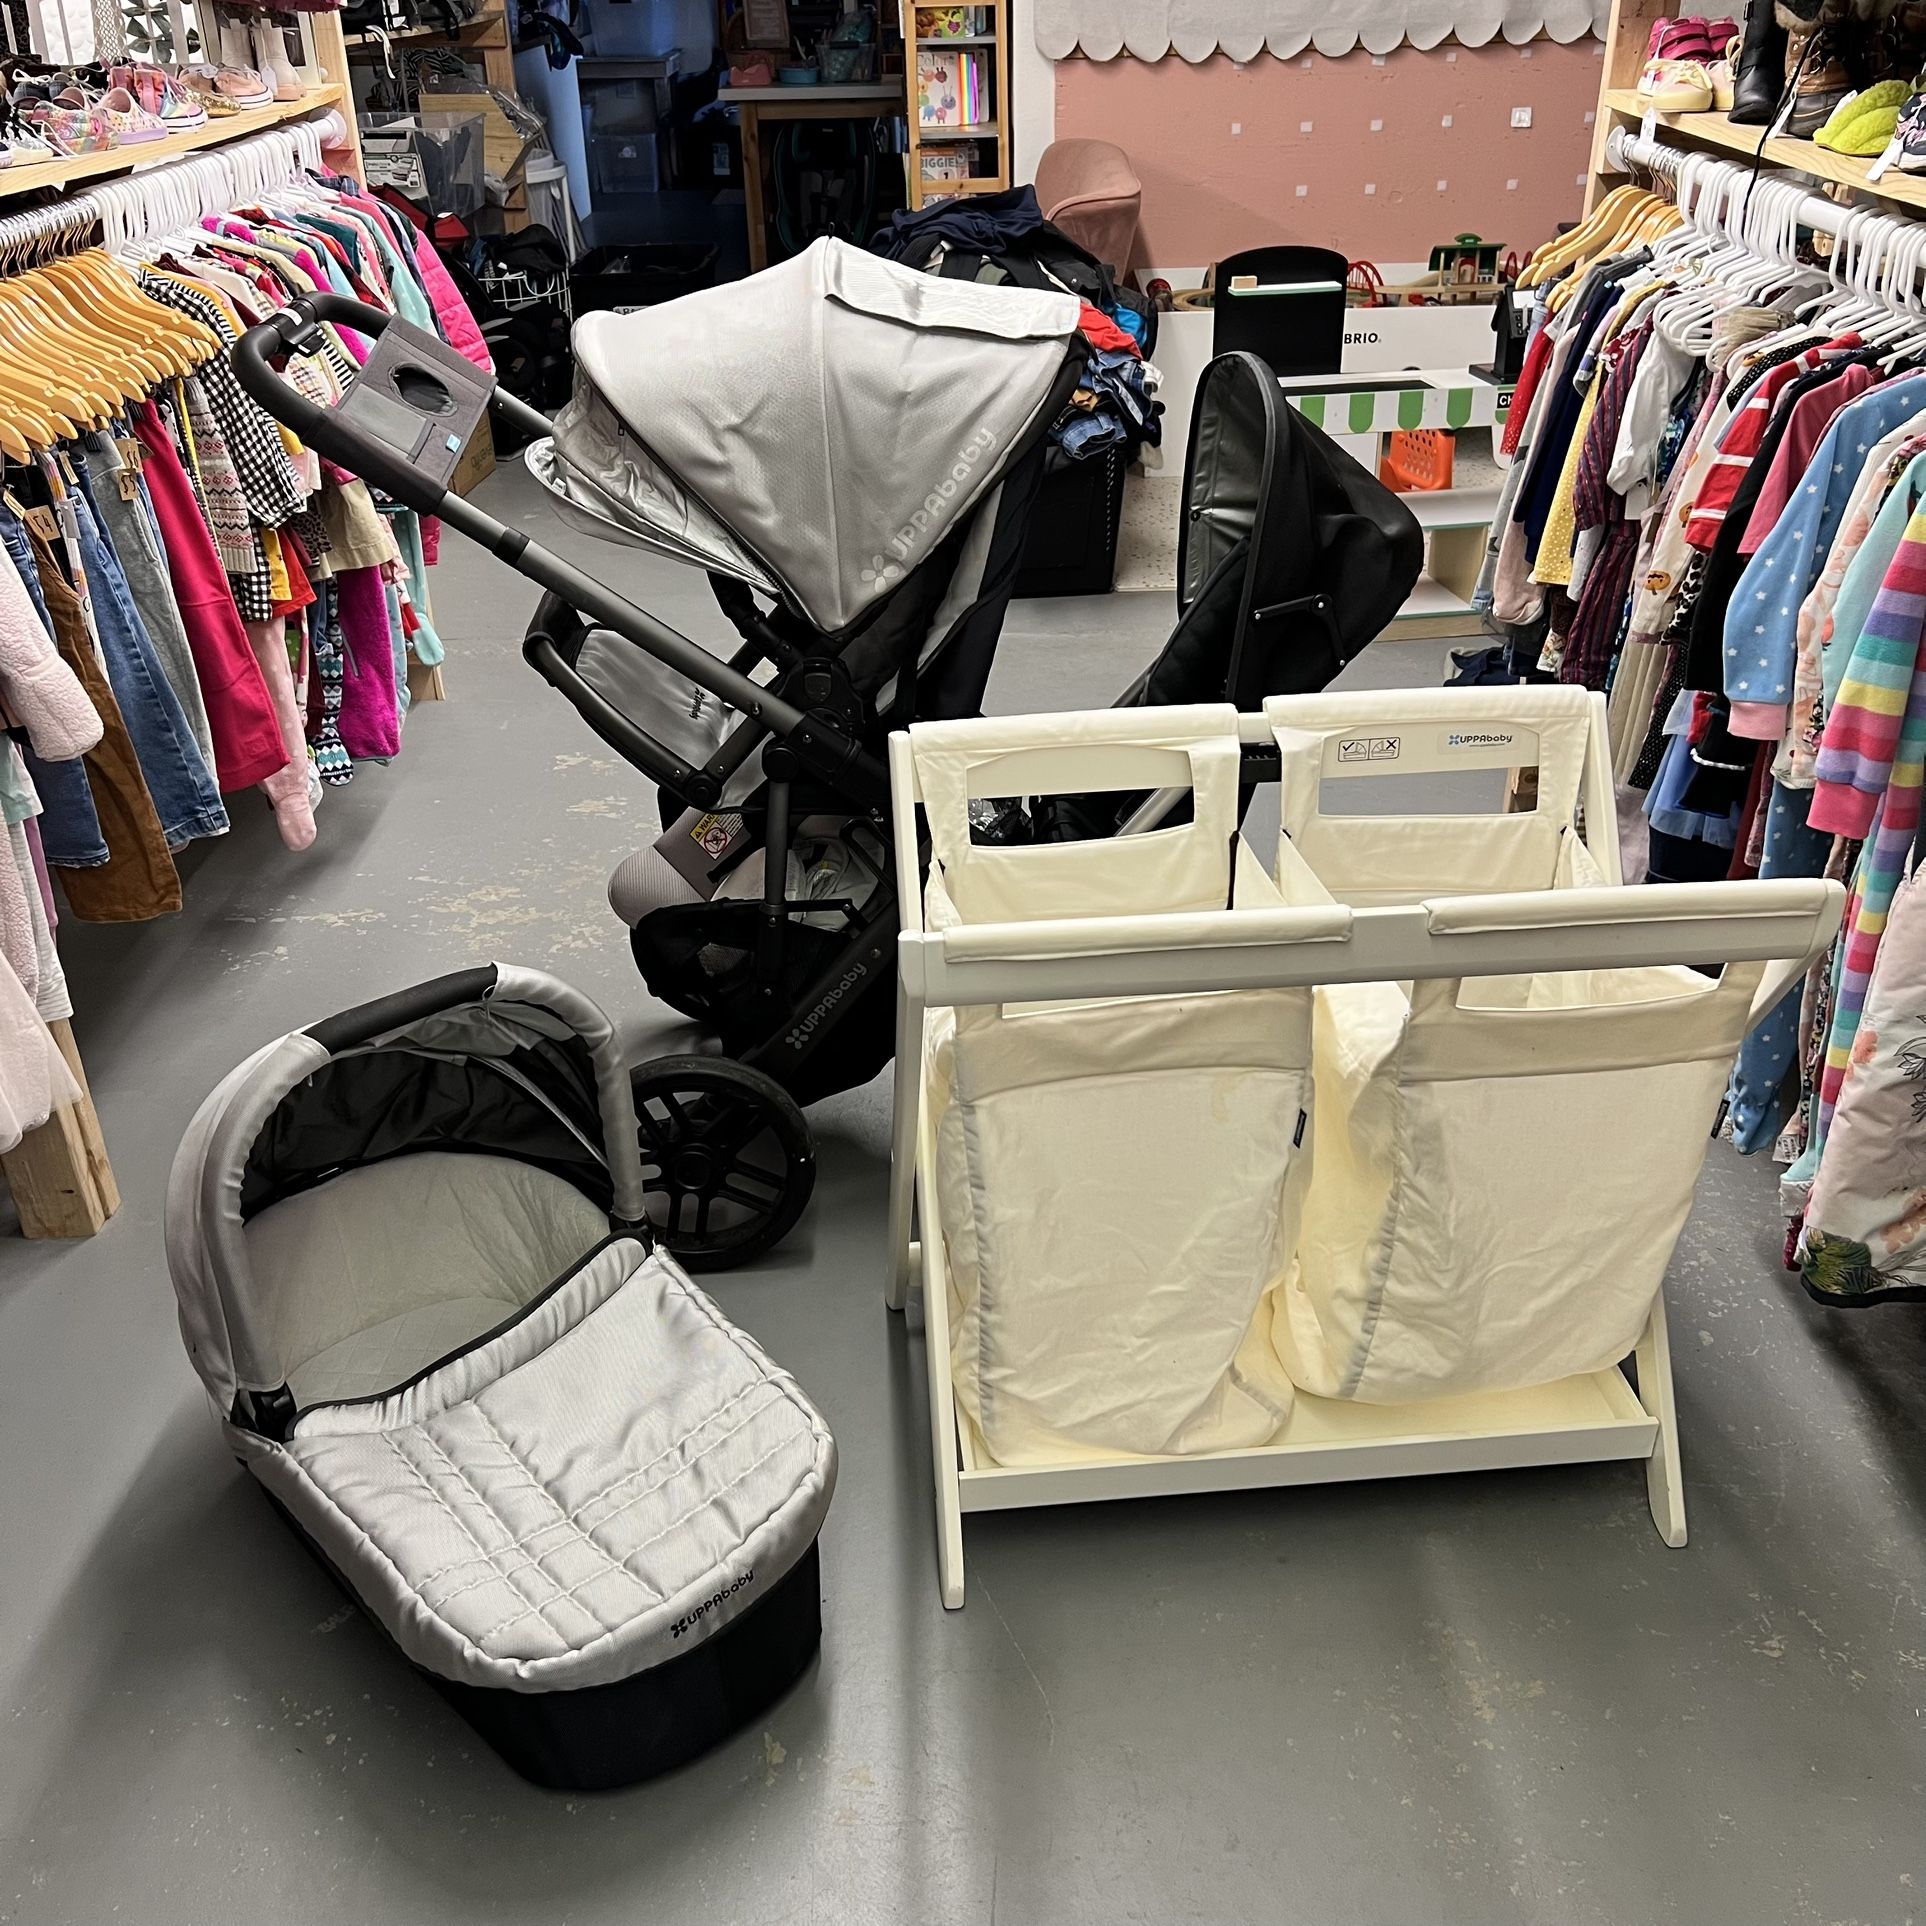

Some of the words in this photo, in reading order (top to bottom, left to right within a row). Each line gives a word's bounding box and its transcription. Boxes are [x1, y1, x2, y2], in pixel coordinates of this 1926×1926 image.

[885, 427, 997, 561] UPPAbaby
[1460, 733, 1513, 743] UPPAbaby
[800, 962, 868, 1032] UPPAbaby
[686, 1569, 755, 1625] UPPAbaby
